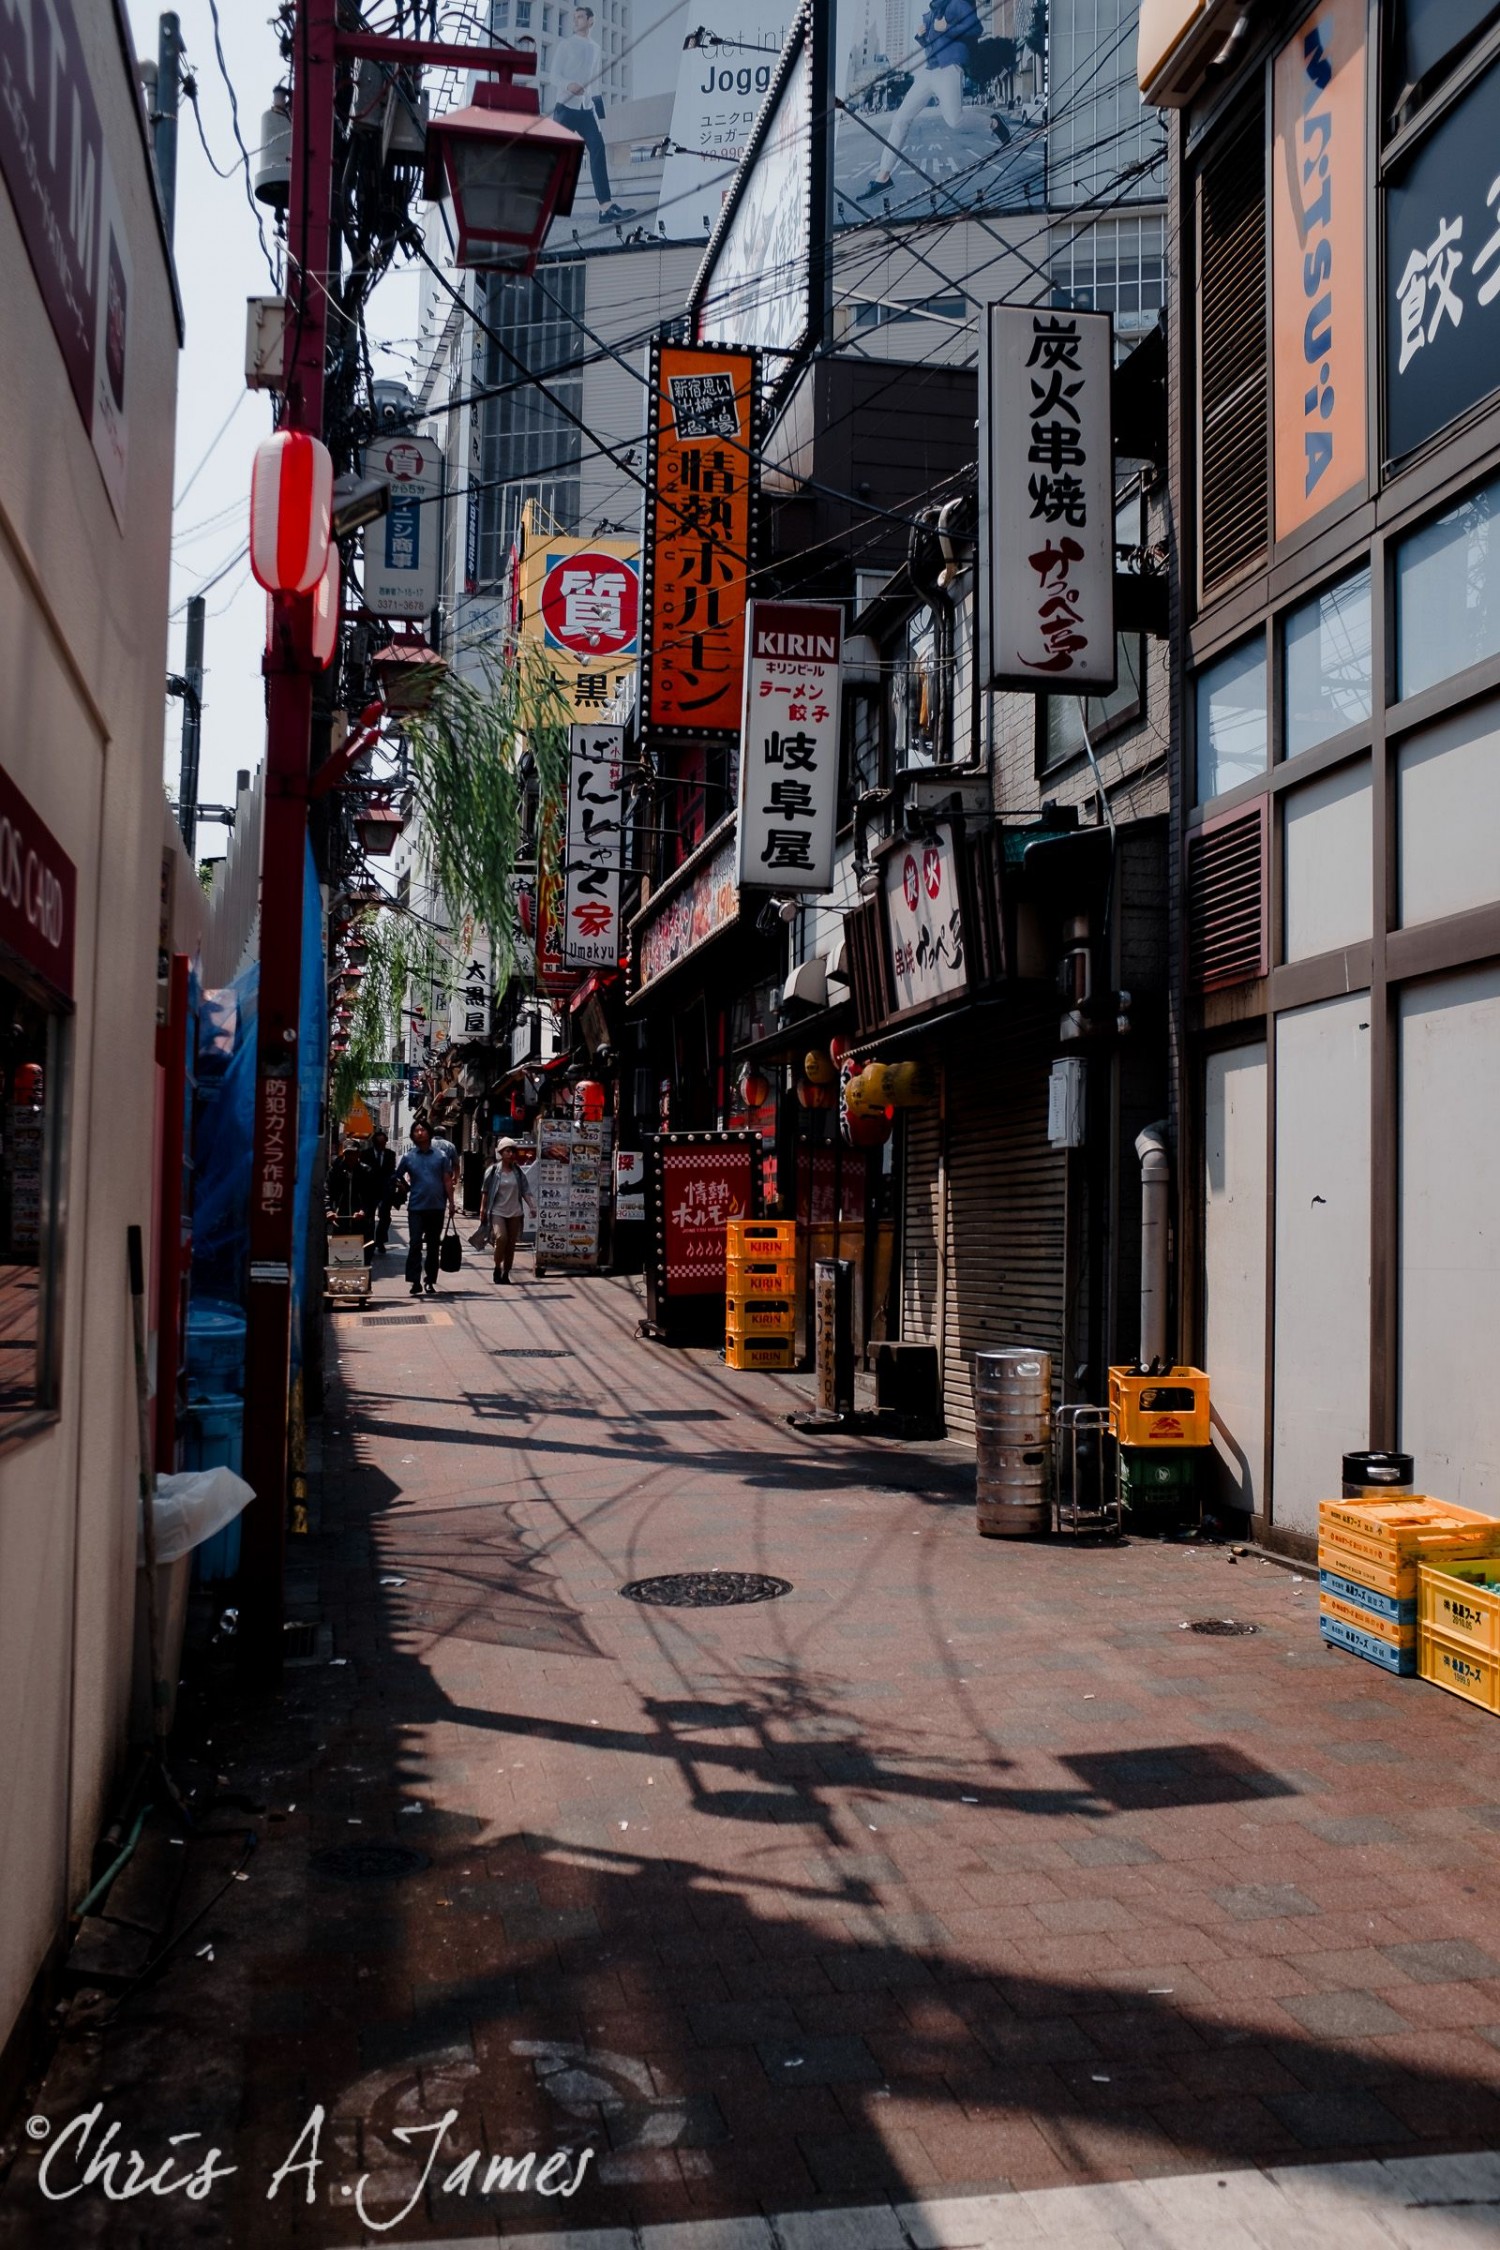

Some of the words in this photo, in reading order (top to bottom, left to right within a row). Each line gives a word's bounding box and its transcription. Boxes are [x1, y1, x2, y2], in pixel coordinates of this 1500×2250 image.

[701, 28, 745, 60] Get
[700, 111, 753, 128] ユニクロ
[675, 448, 735, 713] 情熱ホルモン
[559, 570, 626, 640] 質
[660, 583, 676, 712] HORUMON
[757, 631, 836, 659] KIRIN
[765, 662, 825, 677] キリンビール
[536, 671, 630, 708] 大黒
[758, 681, 824, 701] ラーメン
[788, 703, 830, 723] 餃子
[761, 730, 818, 871] 岐阜屋
[569, 942, 615, 961] Umakyu
[684, 1177, 731, 1207] 情熱
[750, 1242, 783, 1252] KIRIN
[750, 1278, 783, 1289] KIRIN
[751, 1314, 782, 1325] KIRIN
[751, 1351, 782, 1362] KIRIN
